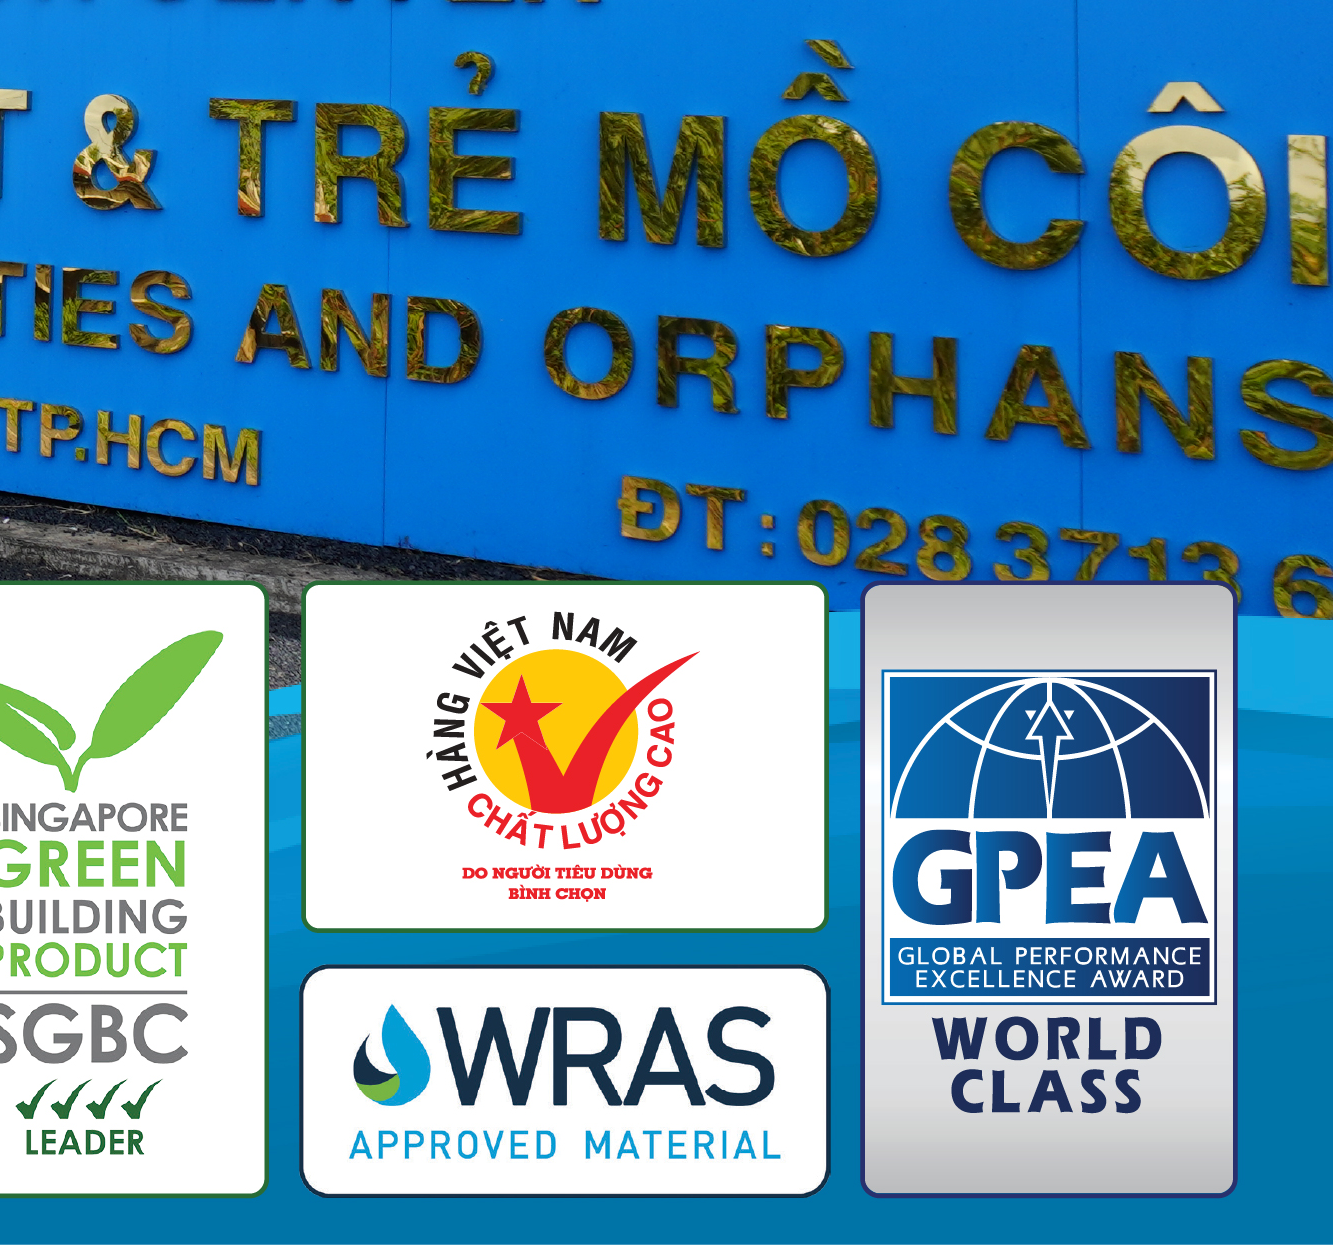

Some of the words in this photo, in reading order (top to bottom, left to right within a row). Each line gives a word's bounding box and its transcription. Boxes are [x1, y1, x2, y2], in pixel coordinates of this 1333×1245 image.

[72, 94, 162, 211] &
[209, 51, 523, 236] TRẺ
[598, 38, 879, 258] MỒ
[949, 81, 1331, 288] CÔI
[235, 282, 484, 385] AND
[543, 304, 1333, 472] ORPHANS
